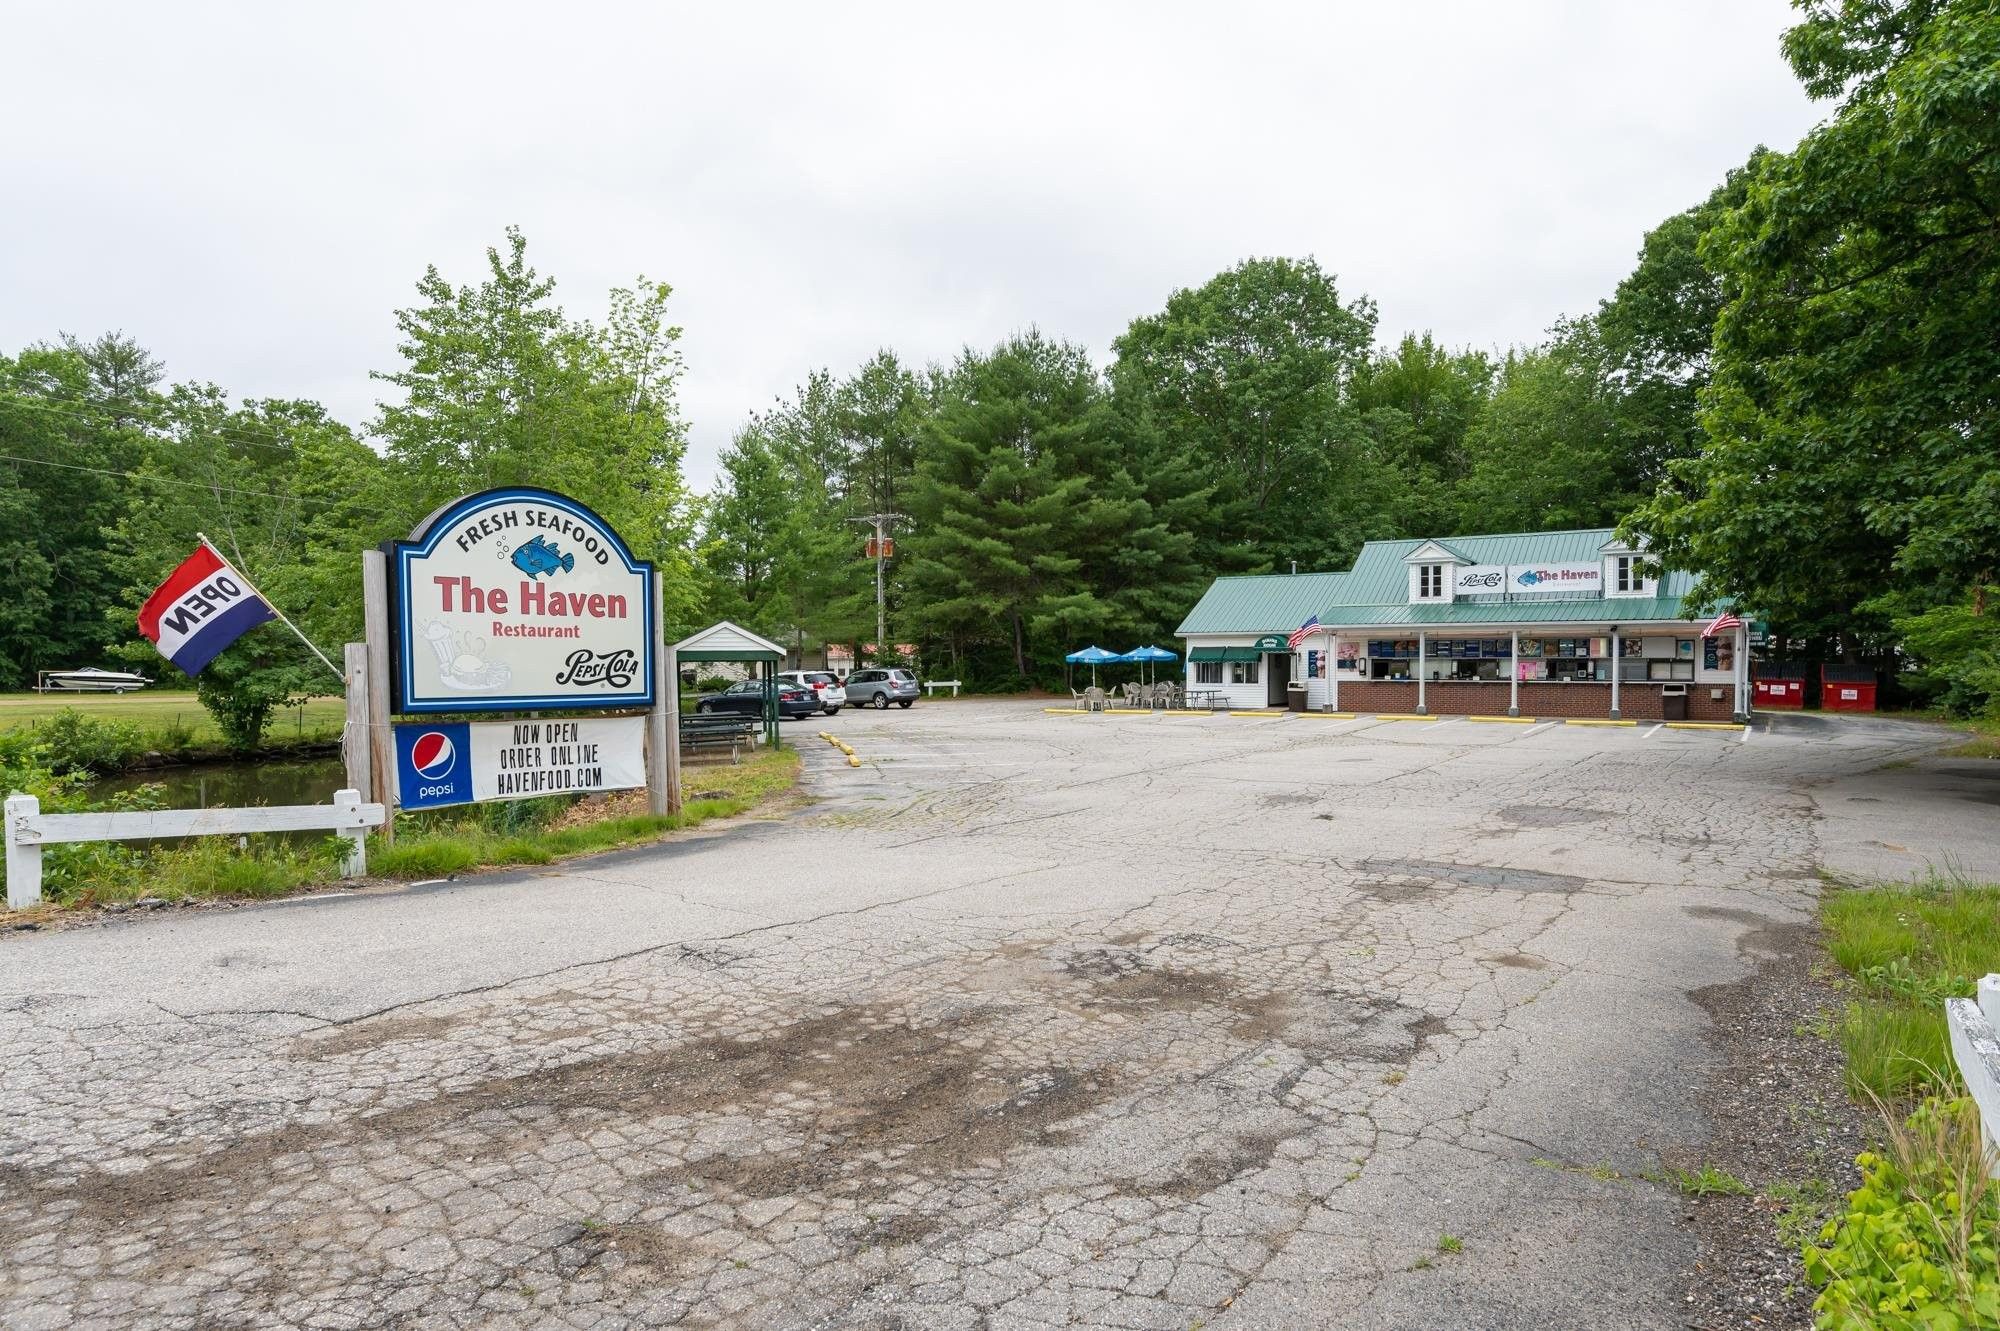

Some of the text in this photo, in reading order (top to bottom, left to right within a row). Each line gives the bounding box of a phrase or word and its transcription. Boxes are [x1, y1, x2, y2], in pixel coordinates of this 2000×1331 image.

[456, 510, 609, 565] FRESH SEAFOOD
[1536, 569, 1598, 580] The Haven
[434, 576, 627, 618] The Haven
[492, 621, 580, 638] Restaurant
[514, 723, 578, 745] NOW OPEN
[500, 744, 598, 769] ORDER ONLINE
[419, 782, 454, 798] pepsi
[498, 767, 602, 794] HAVENFOOD.COM
